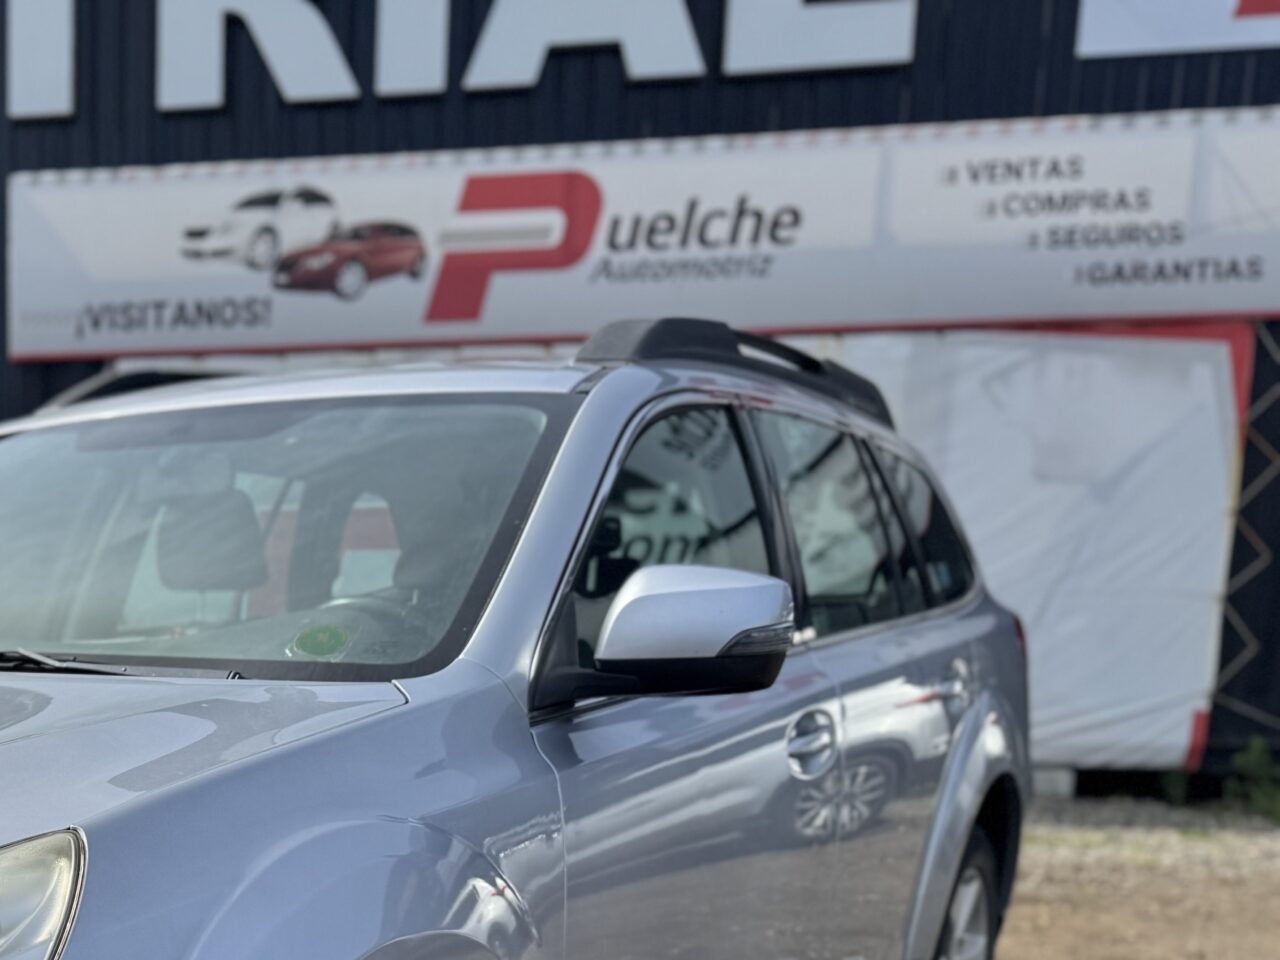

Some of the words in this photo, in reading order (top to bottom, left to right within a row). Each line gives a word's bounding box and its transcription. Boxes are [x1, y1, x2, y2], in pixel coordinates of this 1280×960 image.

[967, 155, 1083, 184] VENTAS
[1001, 187, 1152, 218] COMPRAS
[425, 169, 802, 323] Puelche
[1047, 220, 1185, 250] SEGUROS
[592, 252, 774, 284] Automotriz
[75, 298, 271, 339] ¡VISITANOS!
